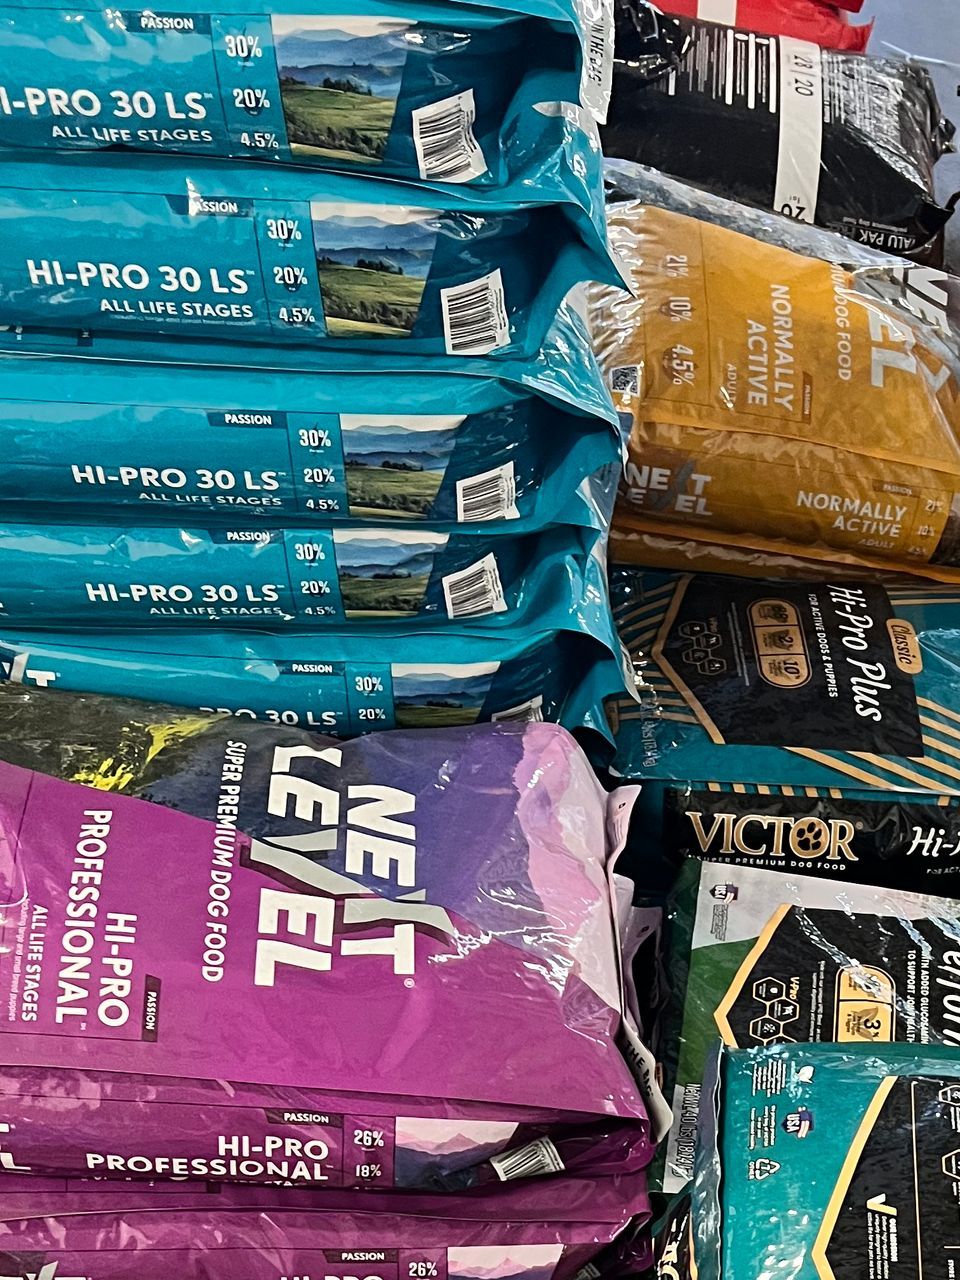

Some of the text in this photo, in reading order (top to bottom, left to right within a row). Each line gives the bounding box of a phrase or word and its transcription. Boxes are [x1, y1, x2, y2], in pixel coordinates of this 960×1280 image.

[140, 17, 194, 30] PASSION
[225, 35, 262, 58] 30%
[233, 88, 270, 108] 20%
[797, 81, 813, 97] 20
[112, 90, 156, 119] 30
[52, 126, 213, 143] ALL LIFE STAGES
[240, 132, 279, 149] 4.5%
[267, 219, 301, 240] 30%
[858, 229, 885, 248] PAK
[26, 259, 150, 291] HI-PRO
[158, 265, 201, 292] 30
[273, 266, 307, 285] 20%
[665, 254, 688, 278] 21%
[100, 299, 254, 318] ALL LIFE STAGES
[279, 307, 315, 324] 4.5%
[669, 296, 693, 322] 10%
[833, 289, 849, 329] DOG
[770, 284, 793, 412] NORMALLY
[836, 331, 851, 381] FOOD
[672, 344, 695, 386] 4.5%
[747, 318, 768, 406] ACTIVE
[225, 413, 272, 425] PASSION
[299, 429, 331, 447] 30%
[71, 465, 187, 489] HI-PRO
[196, 469, 236, 490] 30
[304, 468, 335, 483] 20%
[139, 492, 282, 506] ALL LIFE STAGES
[306, 499, 339, 510] 4.5%
[796, 491, 907, 521] NORMALLY
[227, 531, 270, 542] PASSION
[833, 516, 902, 538] ACTIVE
[294, 543, 325, 560] 30%
[85, 582, 193, 602] HI-PRO
[201, 585, 238, 602] 30
[301, 580, 331, 594] 20%
[150, 607, 281, 616] ALL LIFE STAGES
[304, 606, 336, 616] 4.5%
[808, 593, 838, 698] FOR ACTIVE DOGS PUPPIES
[826, 584, 892, 722] Hi-Pro Plus
[292, 663, 333, 673] PASSION
[355, 676, 384, 692] 30%
[358, 708, 386, 720] 20%
[226, 741, 248, 786] SUPER
[211, 788, 241, 868] PREMIUM
[685, 811, 859, 861] VICTOR
[735, 857, 786, 868] PREMIUM
[790, 860, 813, 869] DOG
[817, 862, 846, 871] FOOD
[207, 869, 232, 918] DOG
[55, 810, 113, 1024] PROFESSIONAL
[201, 922, 228, 982] FOOD
[21, 904, 49, 1022] ALL LIFE STAGES
[97, 912, 138, 1027] HI-PRO
[907, 960, 918, 993] SUPPORT
[919, 970, 930, 995] ADDED
[145, 991, 157, 1030] PASSION
[284, 1112, 329, 1124] PASSION
[218, 1135, 329, 1160] HI-PRO
[353, 1130, 385, 1147] 26%
[86, 1153, 329, 1181] PROFESSIONAL
[355, 1164, 382, 1178] 18%
[341, 1252, 385, 1261] PASSION
[408, 1262, 438, 1277] 26%
